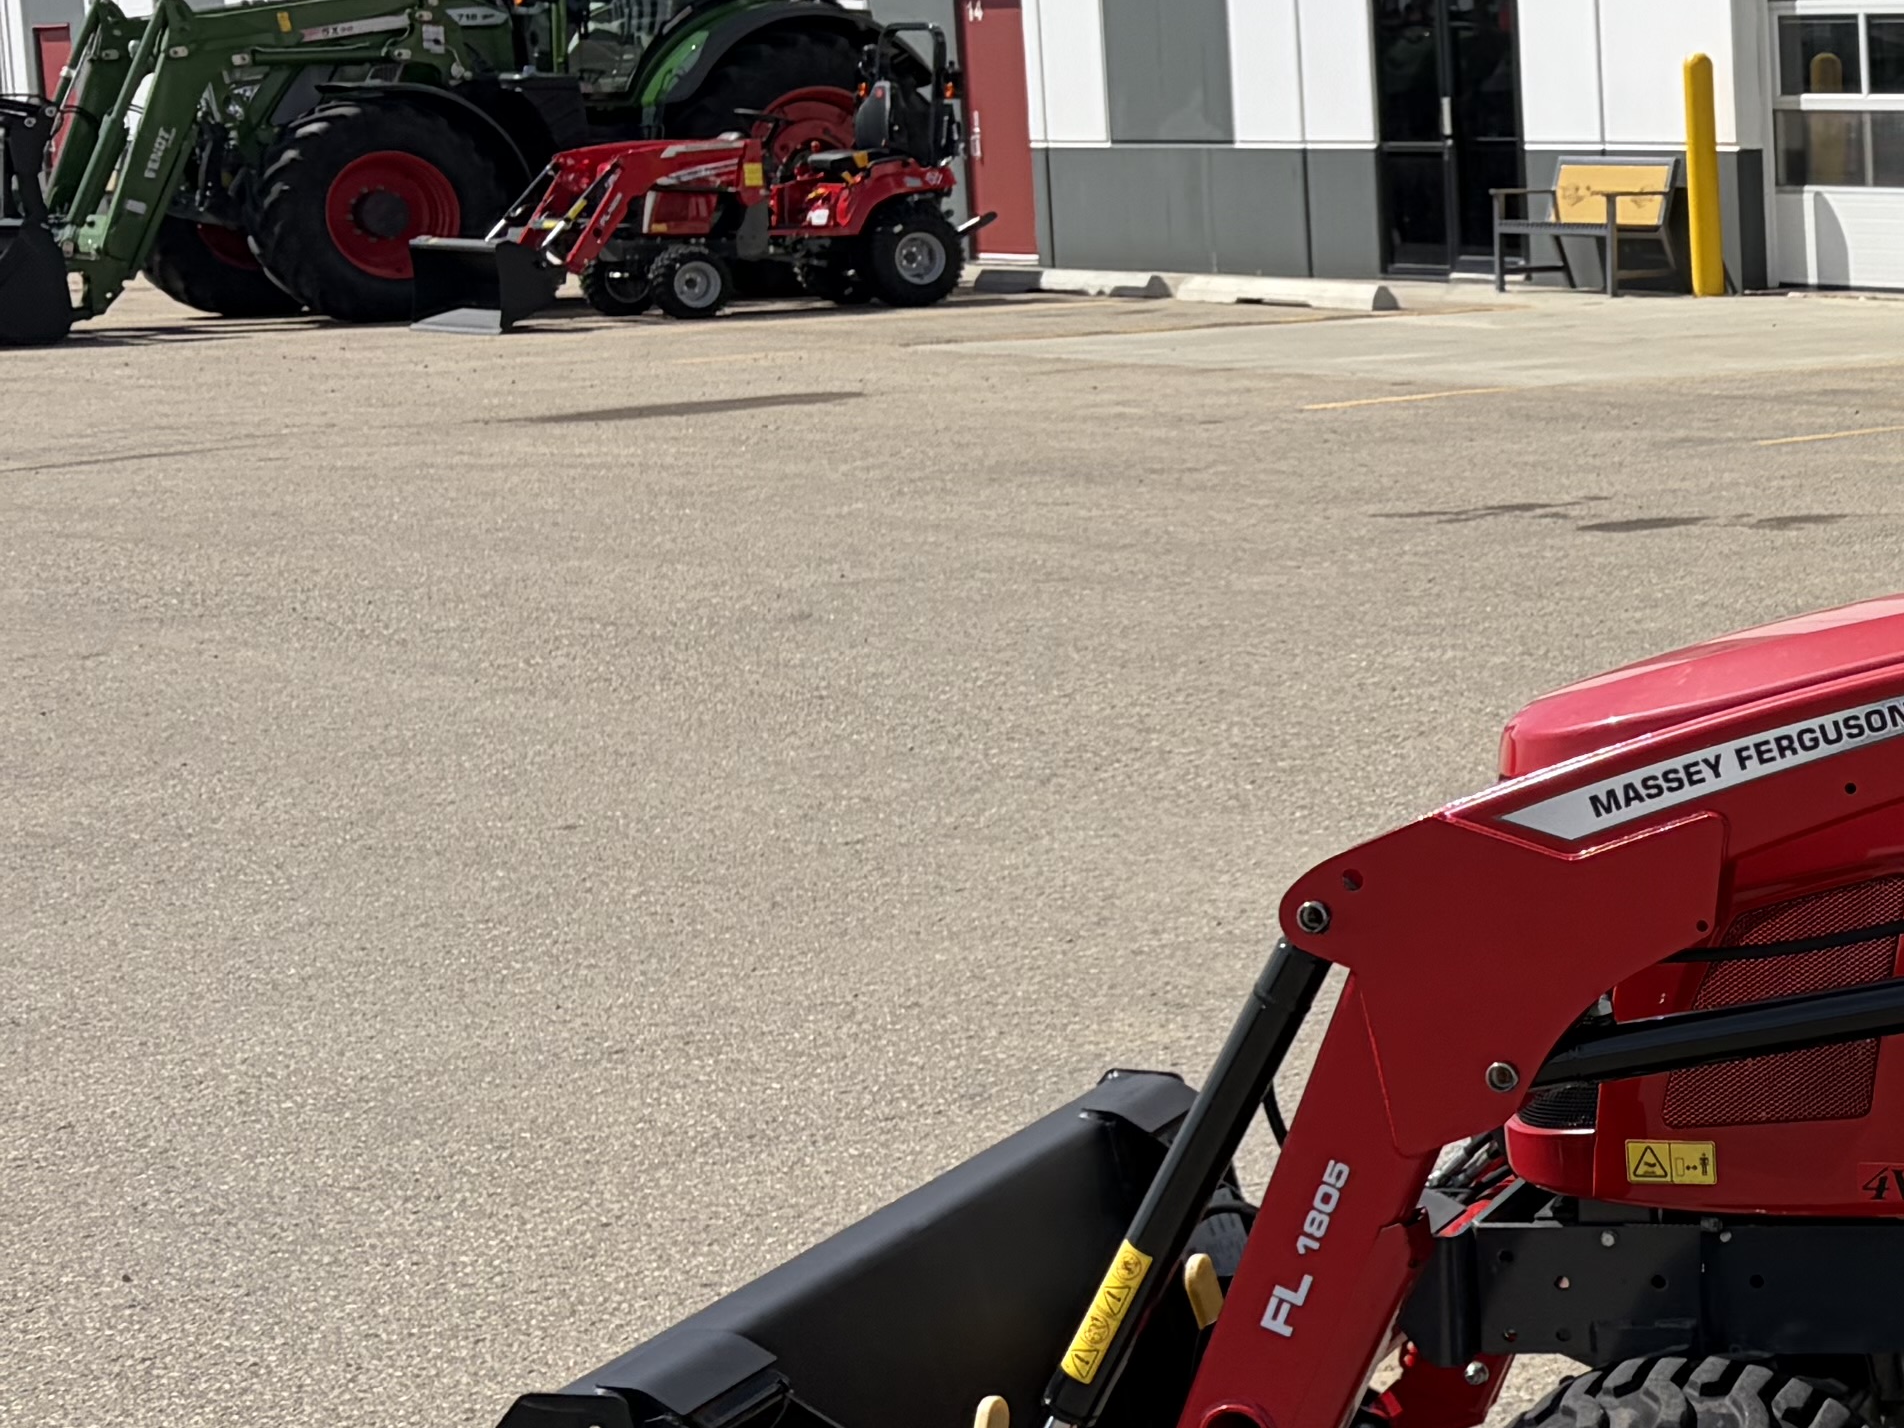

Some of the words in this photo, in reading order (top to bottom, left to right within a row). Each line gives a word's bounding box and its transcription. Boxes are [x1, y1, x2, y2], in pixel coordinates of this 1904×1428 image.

[144, 126, 177, 179] FENDT
[1590, 754, 1724, 818] MASSEY
[1261, 1274, 1313, 1337] FL
[1297, 1159, 1350, 1255] 1805
